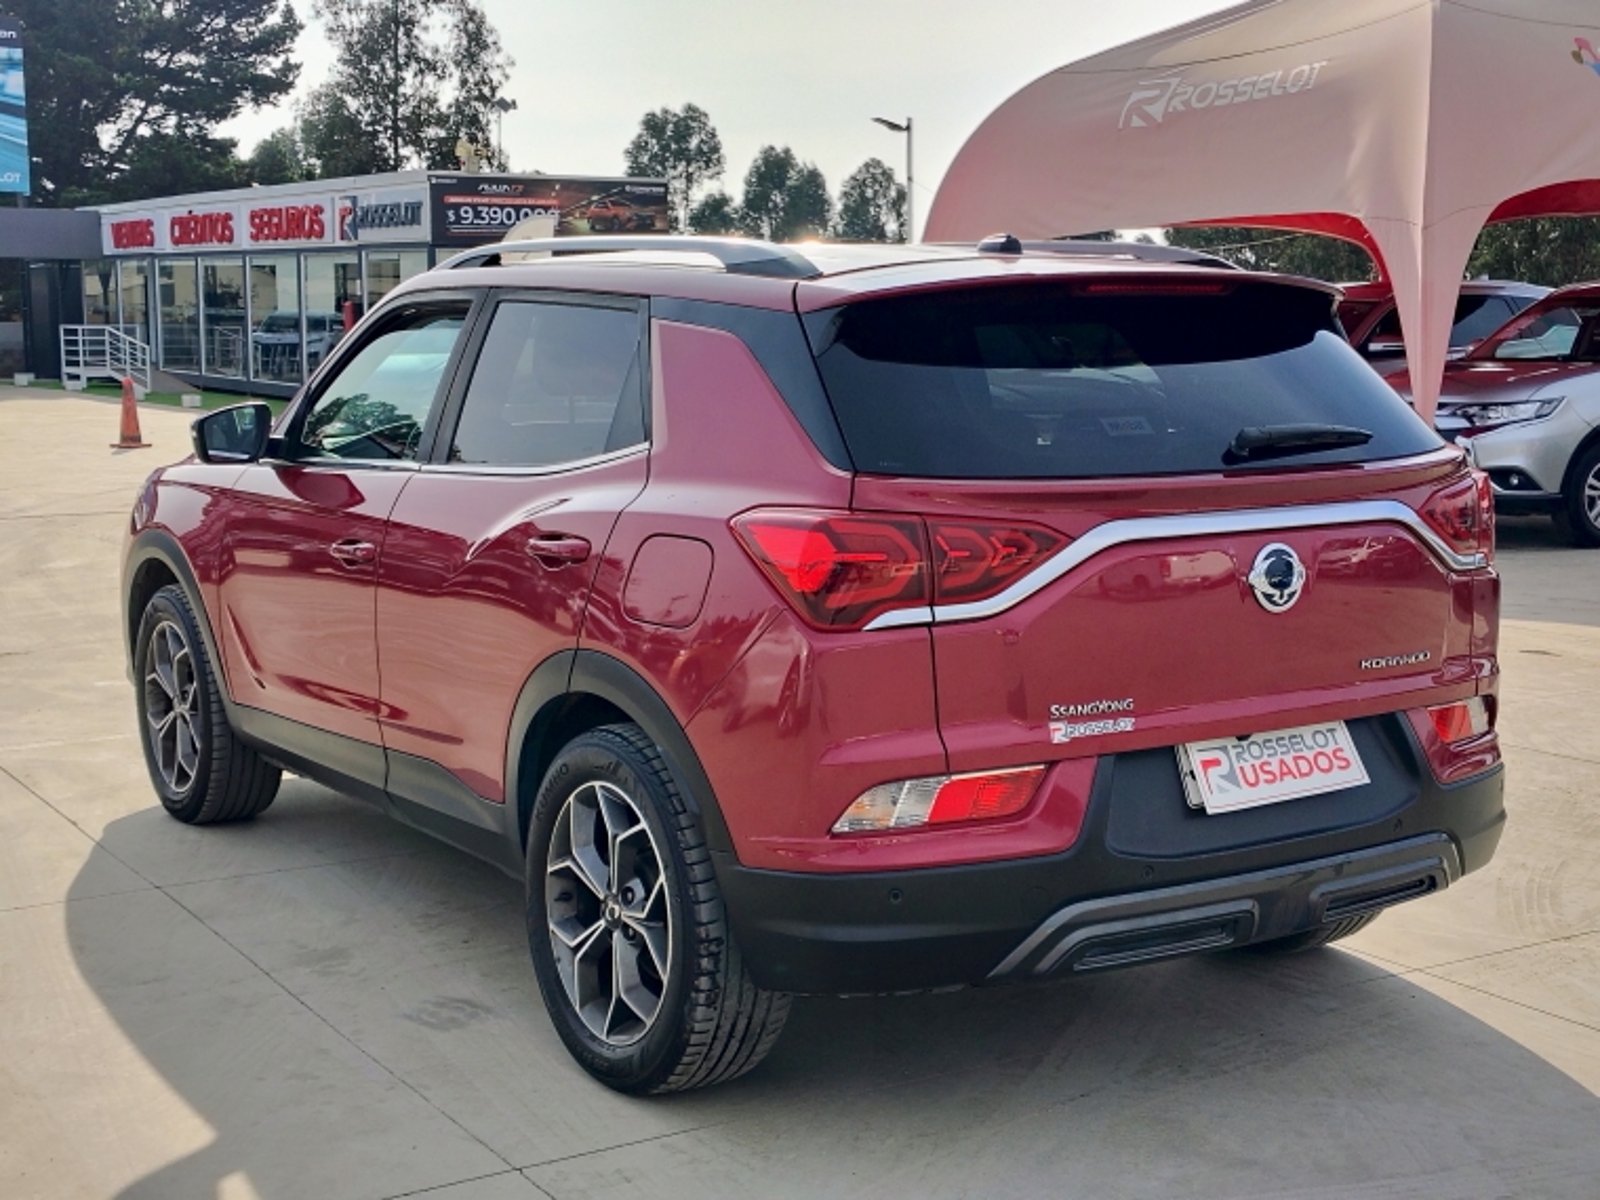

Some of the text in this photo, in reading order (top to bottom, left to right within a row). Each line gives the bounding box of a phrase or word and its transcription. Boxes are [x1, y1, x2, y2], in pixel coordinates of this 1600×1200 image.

[1168, 61, 1328, 113] ROSSELOT
[249, 204, 325, 241] SEGUROS
[1361, 650, 1431, 669] KORANDO
[1231, 728, 1339, 764] ROSSELOT
[1239, 747, 1352, 787] USADOS
